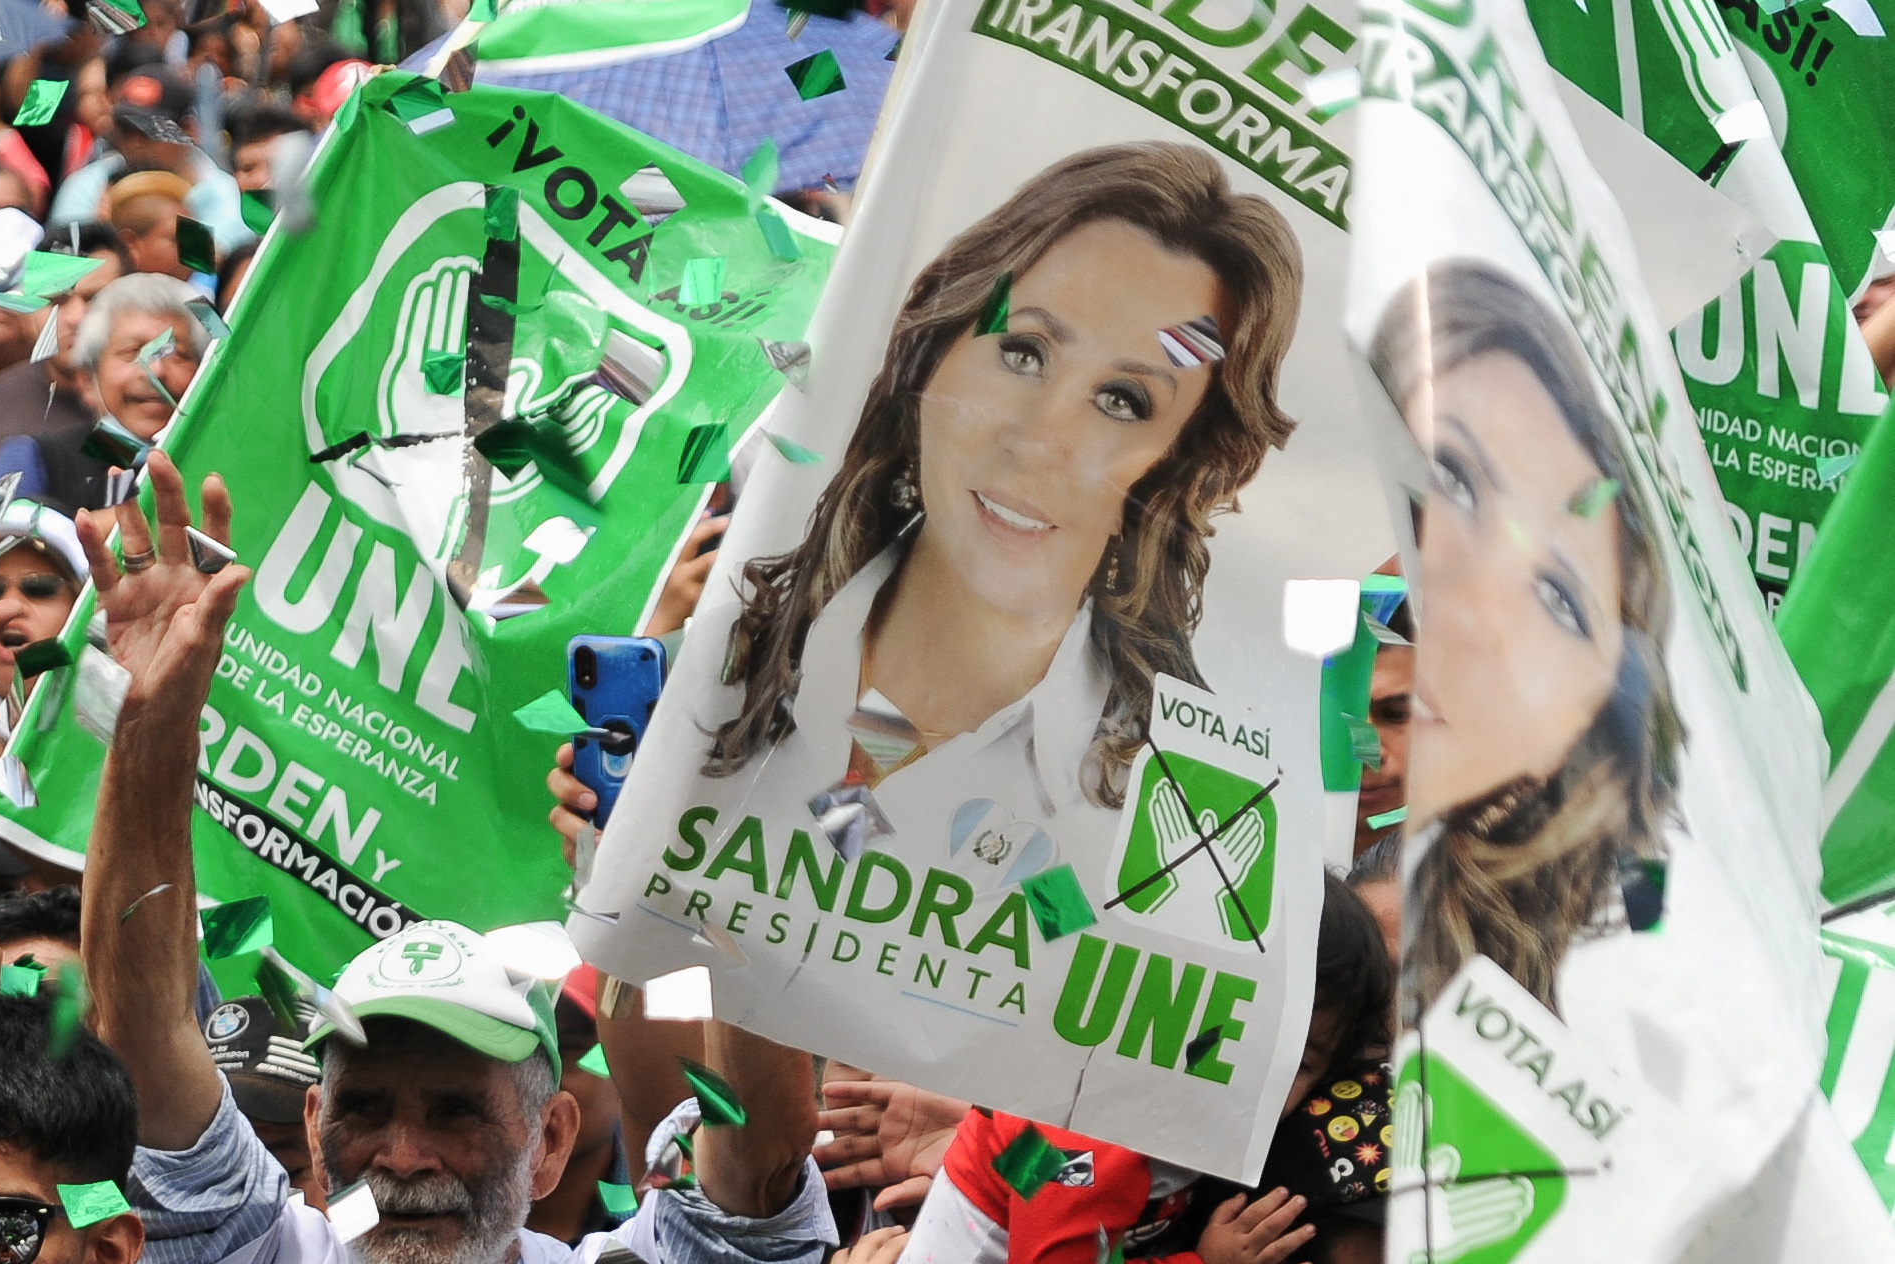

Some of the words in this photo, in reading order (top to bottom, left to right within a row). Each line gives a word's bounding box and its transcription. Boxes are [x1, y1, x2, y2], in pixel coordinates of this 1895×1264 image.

[485, 105, 654, 285] ¡VOTA
[1696, 407, 1762, 442] NIDAD
[215, 652, 254, 690] DE
[254, 678, 286, 716] LA
[291, 703, 438, 806] ESPERANZA
[224, 622, 323, 698] UNIDAD
[323, 687, 460, 781] NACIONAL
[1158, 691, 1228, 744] VOTA
[1232, 726, 1272, 761] ASÍ
[198, 703, 383, 867] RDEN
[370, 847, 402, 884] Y
[643, 872, 1028, 1016] PRESIDENTA
[662, 804, 1032, 971] SANDRA
[1052, 932, 1258, 1086] UNE
[1455, 978, 1556, 1088] VOTA
[1547, 1076, 1634, 1141] ASÍ
